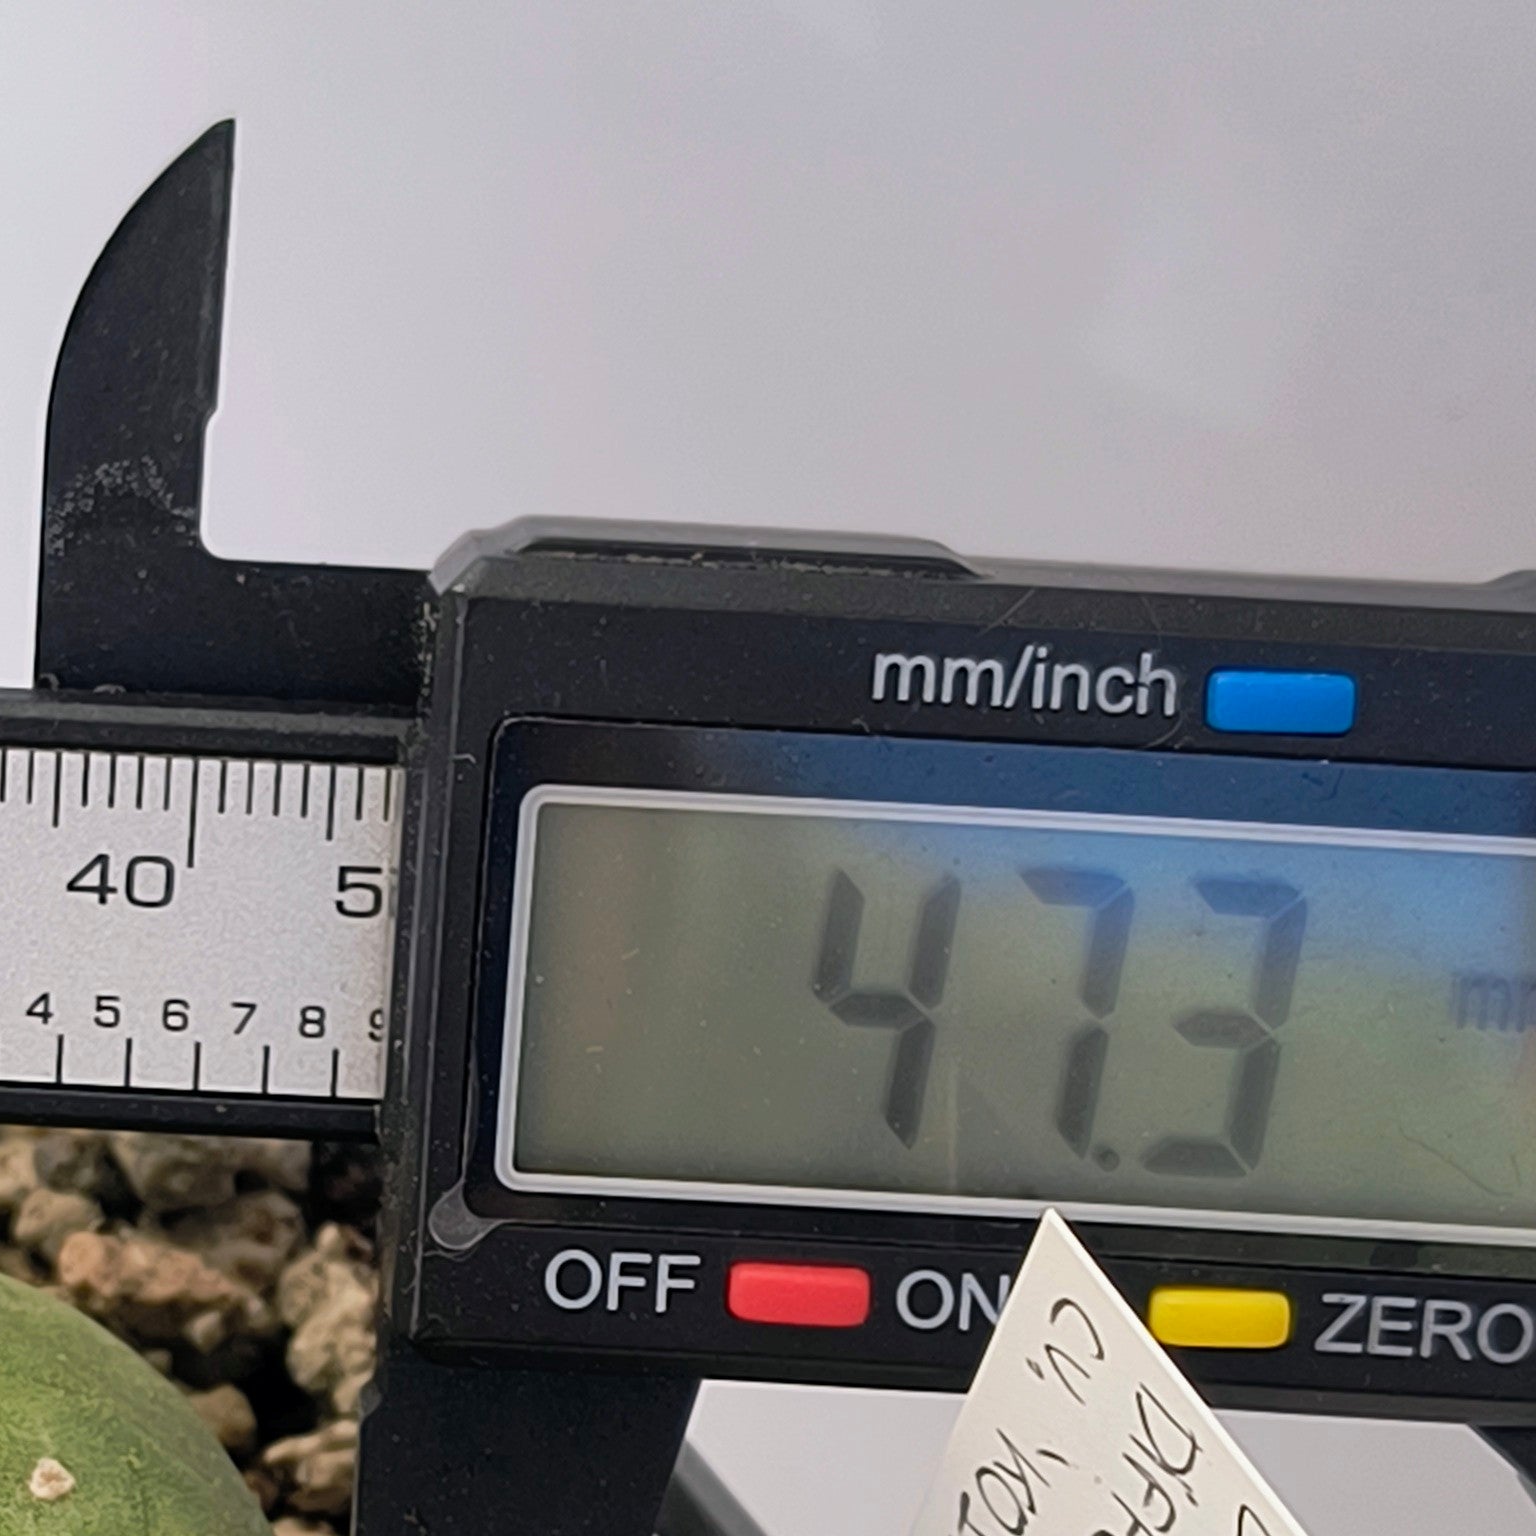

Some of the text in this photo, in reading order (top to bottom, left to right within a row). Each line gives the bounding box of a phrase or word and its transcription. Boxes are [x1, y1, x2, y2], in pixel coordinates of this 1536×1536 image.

[871, 645, 1178, 718] mm/inch
[66, 853, 175, 908] 40
[26, 992, 54, 1025] 4
[94, 995, 121, 1028] 5
[162, 999, 189, 1032] 6
[231, 1002, 257, 1034] 7
[298, 1005, 326, 1039] 8
[810, 866, 1308, 1178] 47.3
[544, 1248, 701, 1313] OFF
[895, 1269, 1011, 1331] ON
[1314, 1293, 1534, 1364] ZERO
